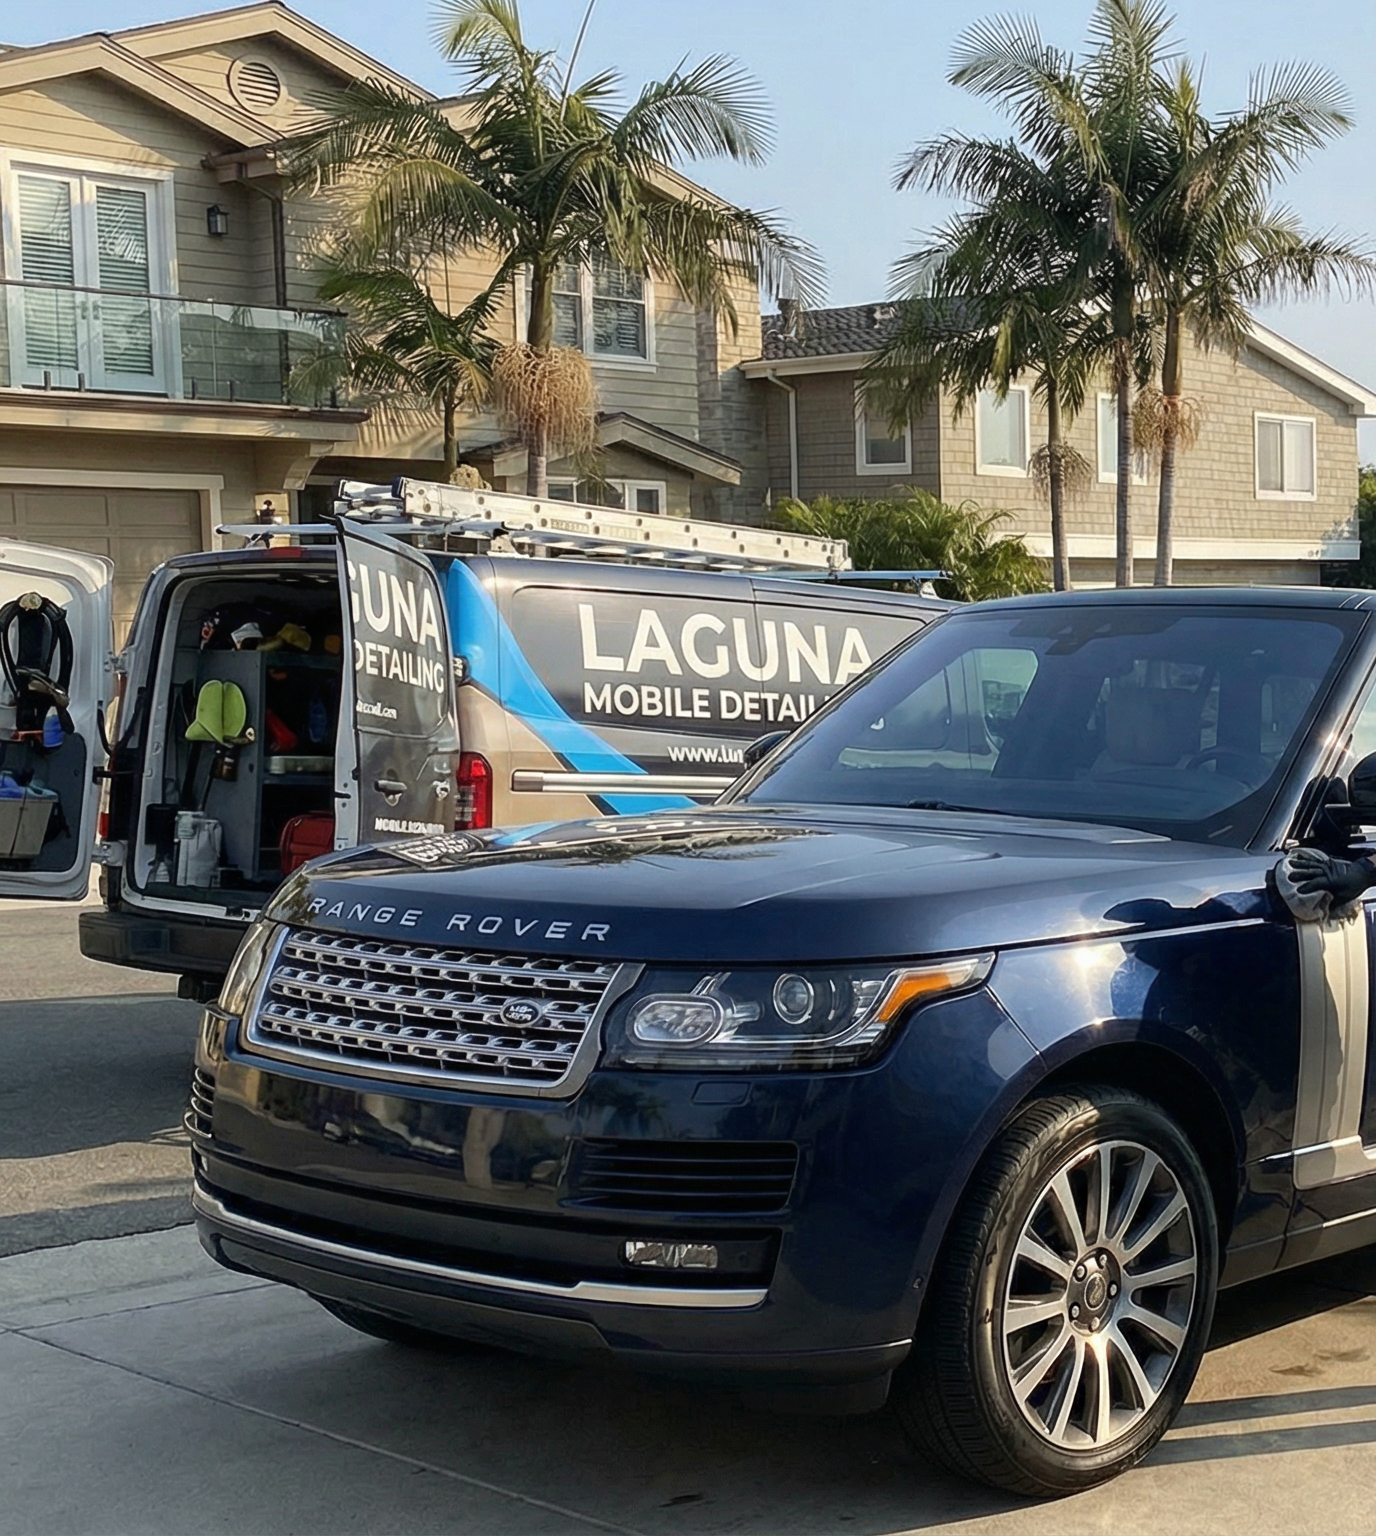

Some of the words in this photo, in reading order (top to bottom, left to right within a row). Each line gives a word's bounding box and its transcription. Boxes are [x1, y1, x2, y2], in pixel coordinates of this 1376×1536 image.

[579, 603, 873, 685] LAGUNA
[584, 682, 711, 718] MOBILE
[307, 898, 423, 926] RANGE
[446, 914, 610, 941] ROVER
